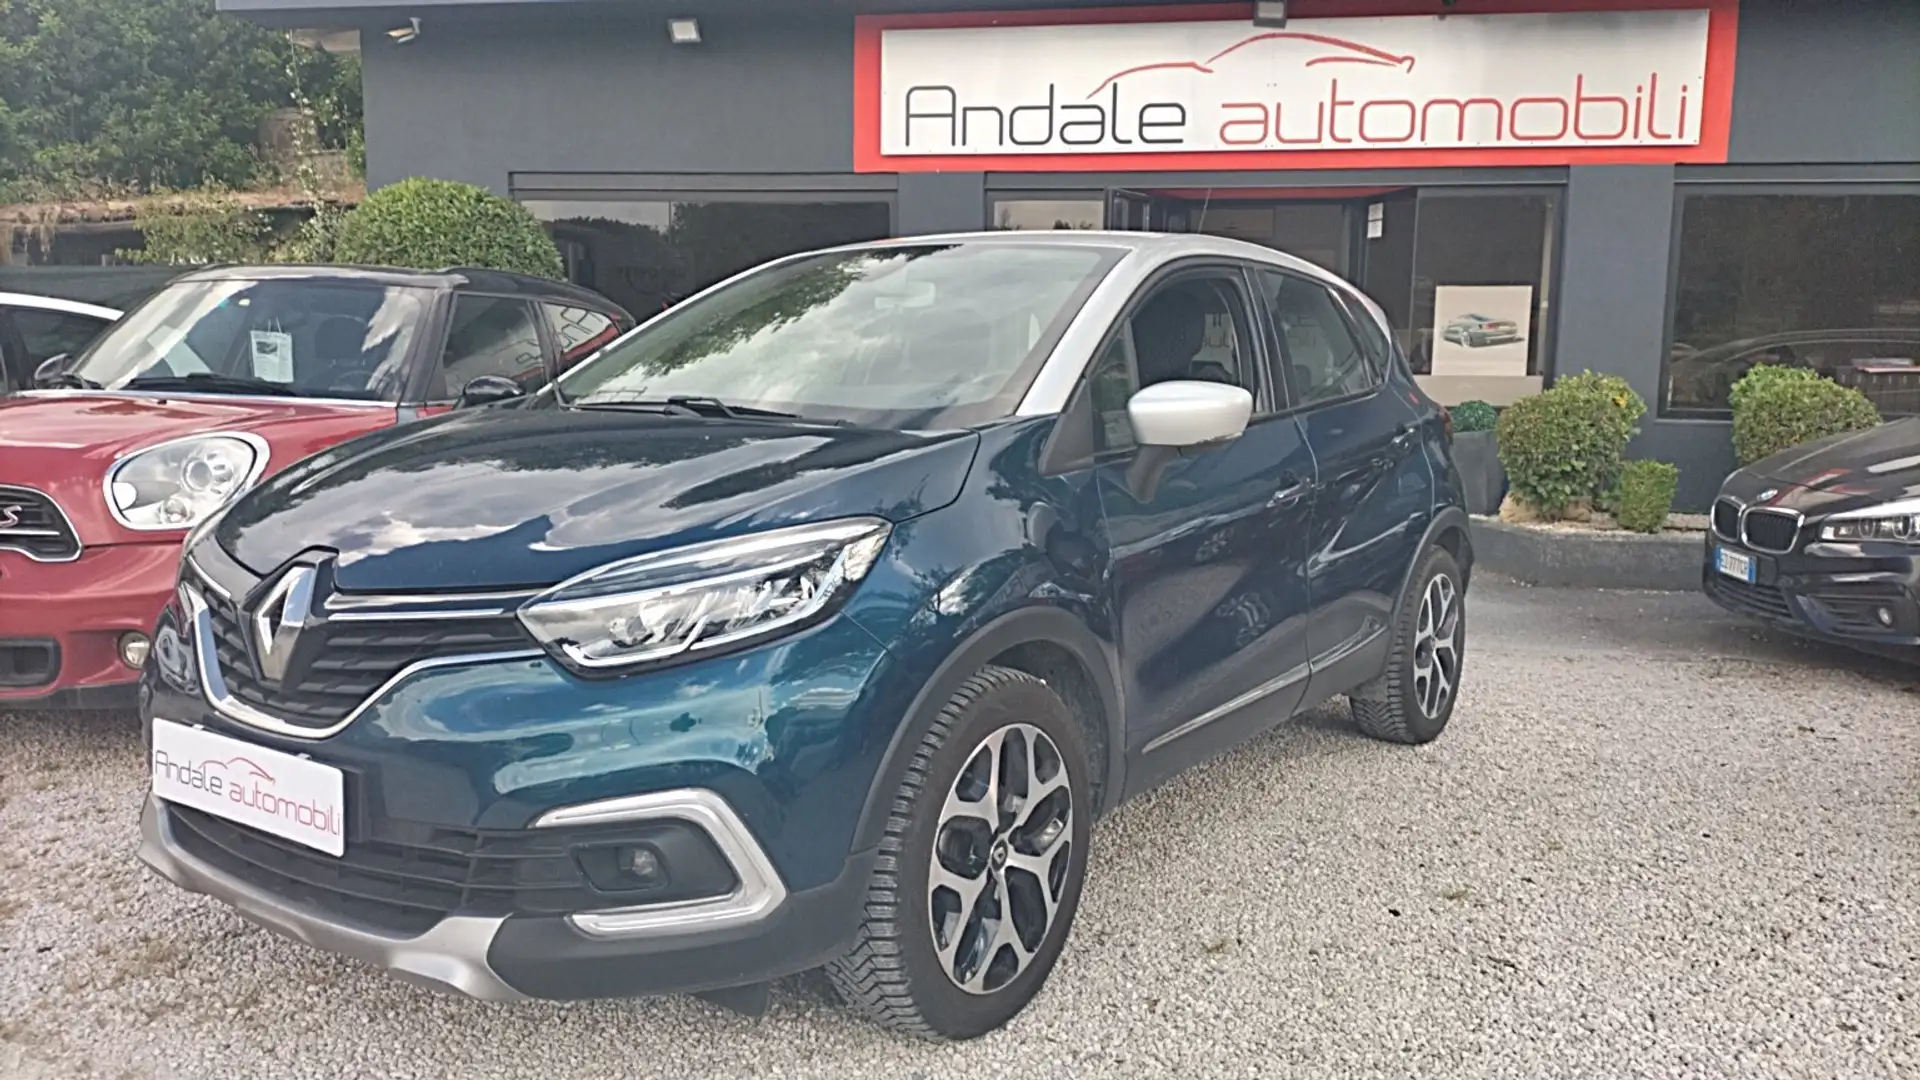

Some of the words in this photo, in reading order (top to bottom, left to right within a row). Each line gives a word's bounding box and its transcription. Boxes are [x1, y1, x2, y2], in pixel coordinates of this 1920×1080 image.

[905, 82, 1186, 147] Andale
[1219, 72, 1688, 145] automobili
[154, 749, 223, 796] Andale
[229, 780, 341, 837] automobili
